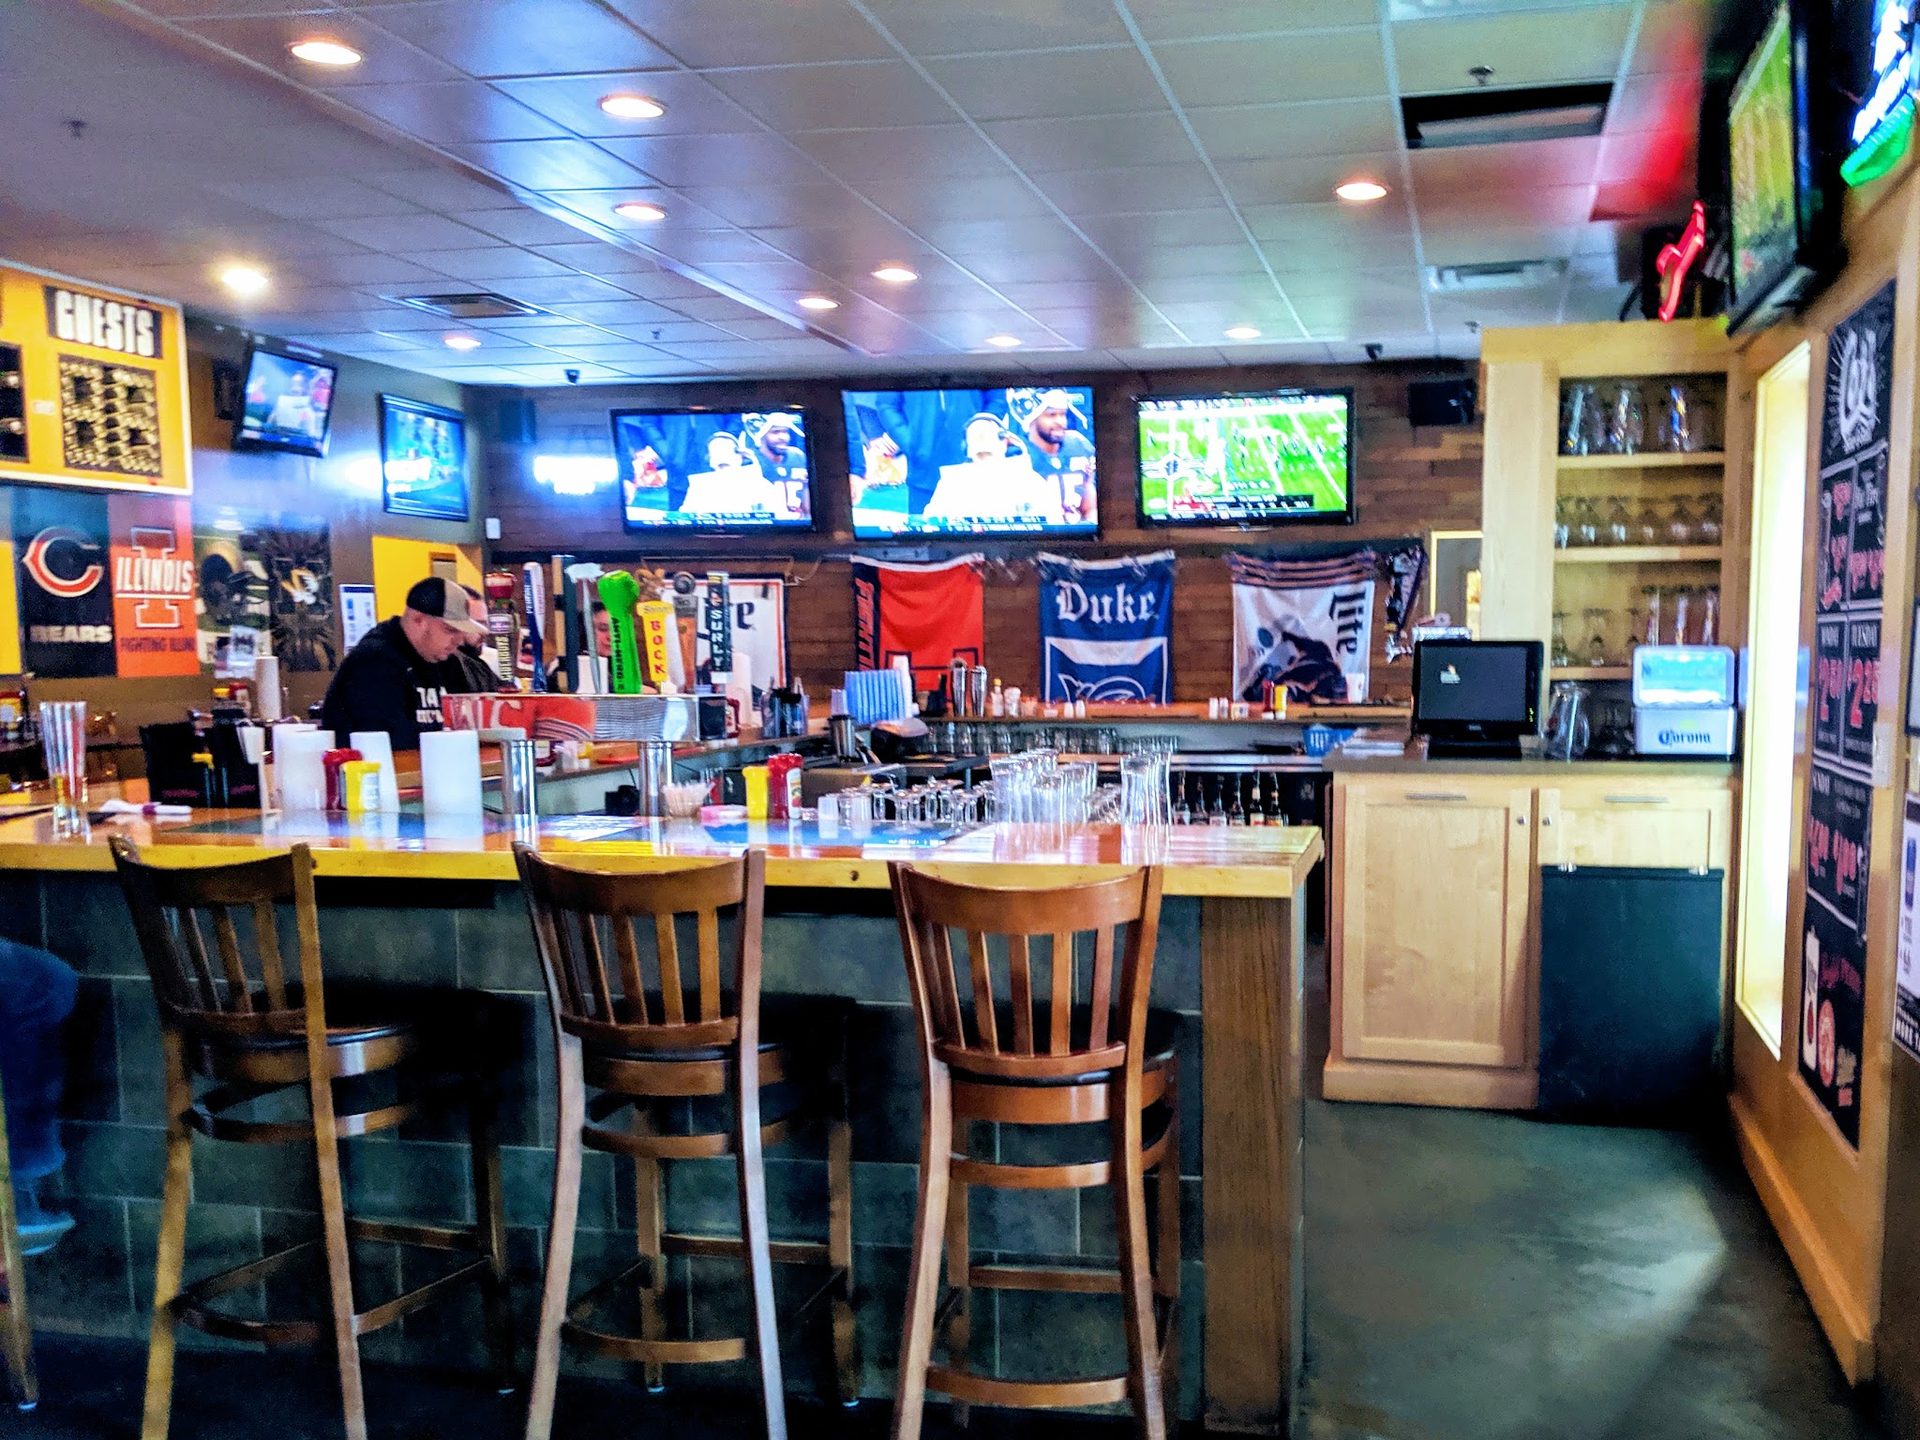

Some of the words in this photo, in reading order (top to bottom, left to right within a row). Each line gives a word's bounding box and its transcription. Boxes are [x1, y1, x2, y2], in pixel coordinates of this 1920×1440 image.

[55, 289, 155, 357] GUESTS
[115, 556, 195, 593] ILLINOIS
[1054, 580, 1159, 623] Duke
[1329, 590, 1367, 655] Lite
[30, 624, 113, 643] BEARS
[650, 620, 665, 674] BOCK
[709, 609, 724, 667] SURLY
[1658, 729, 1711, 748] Corona
